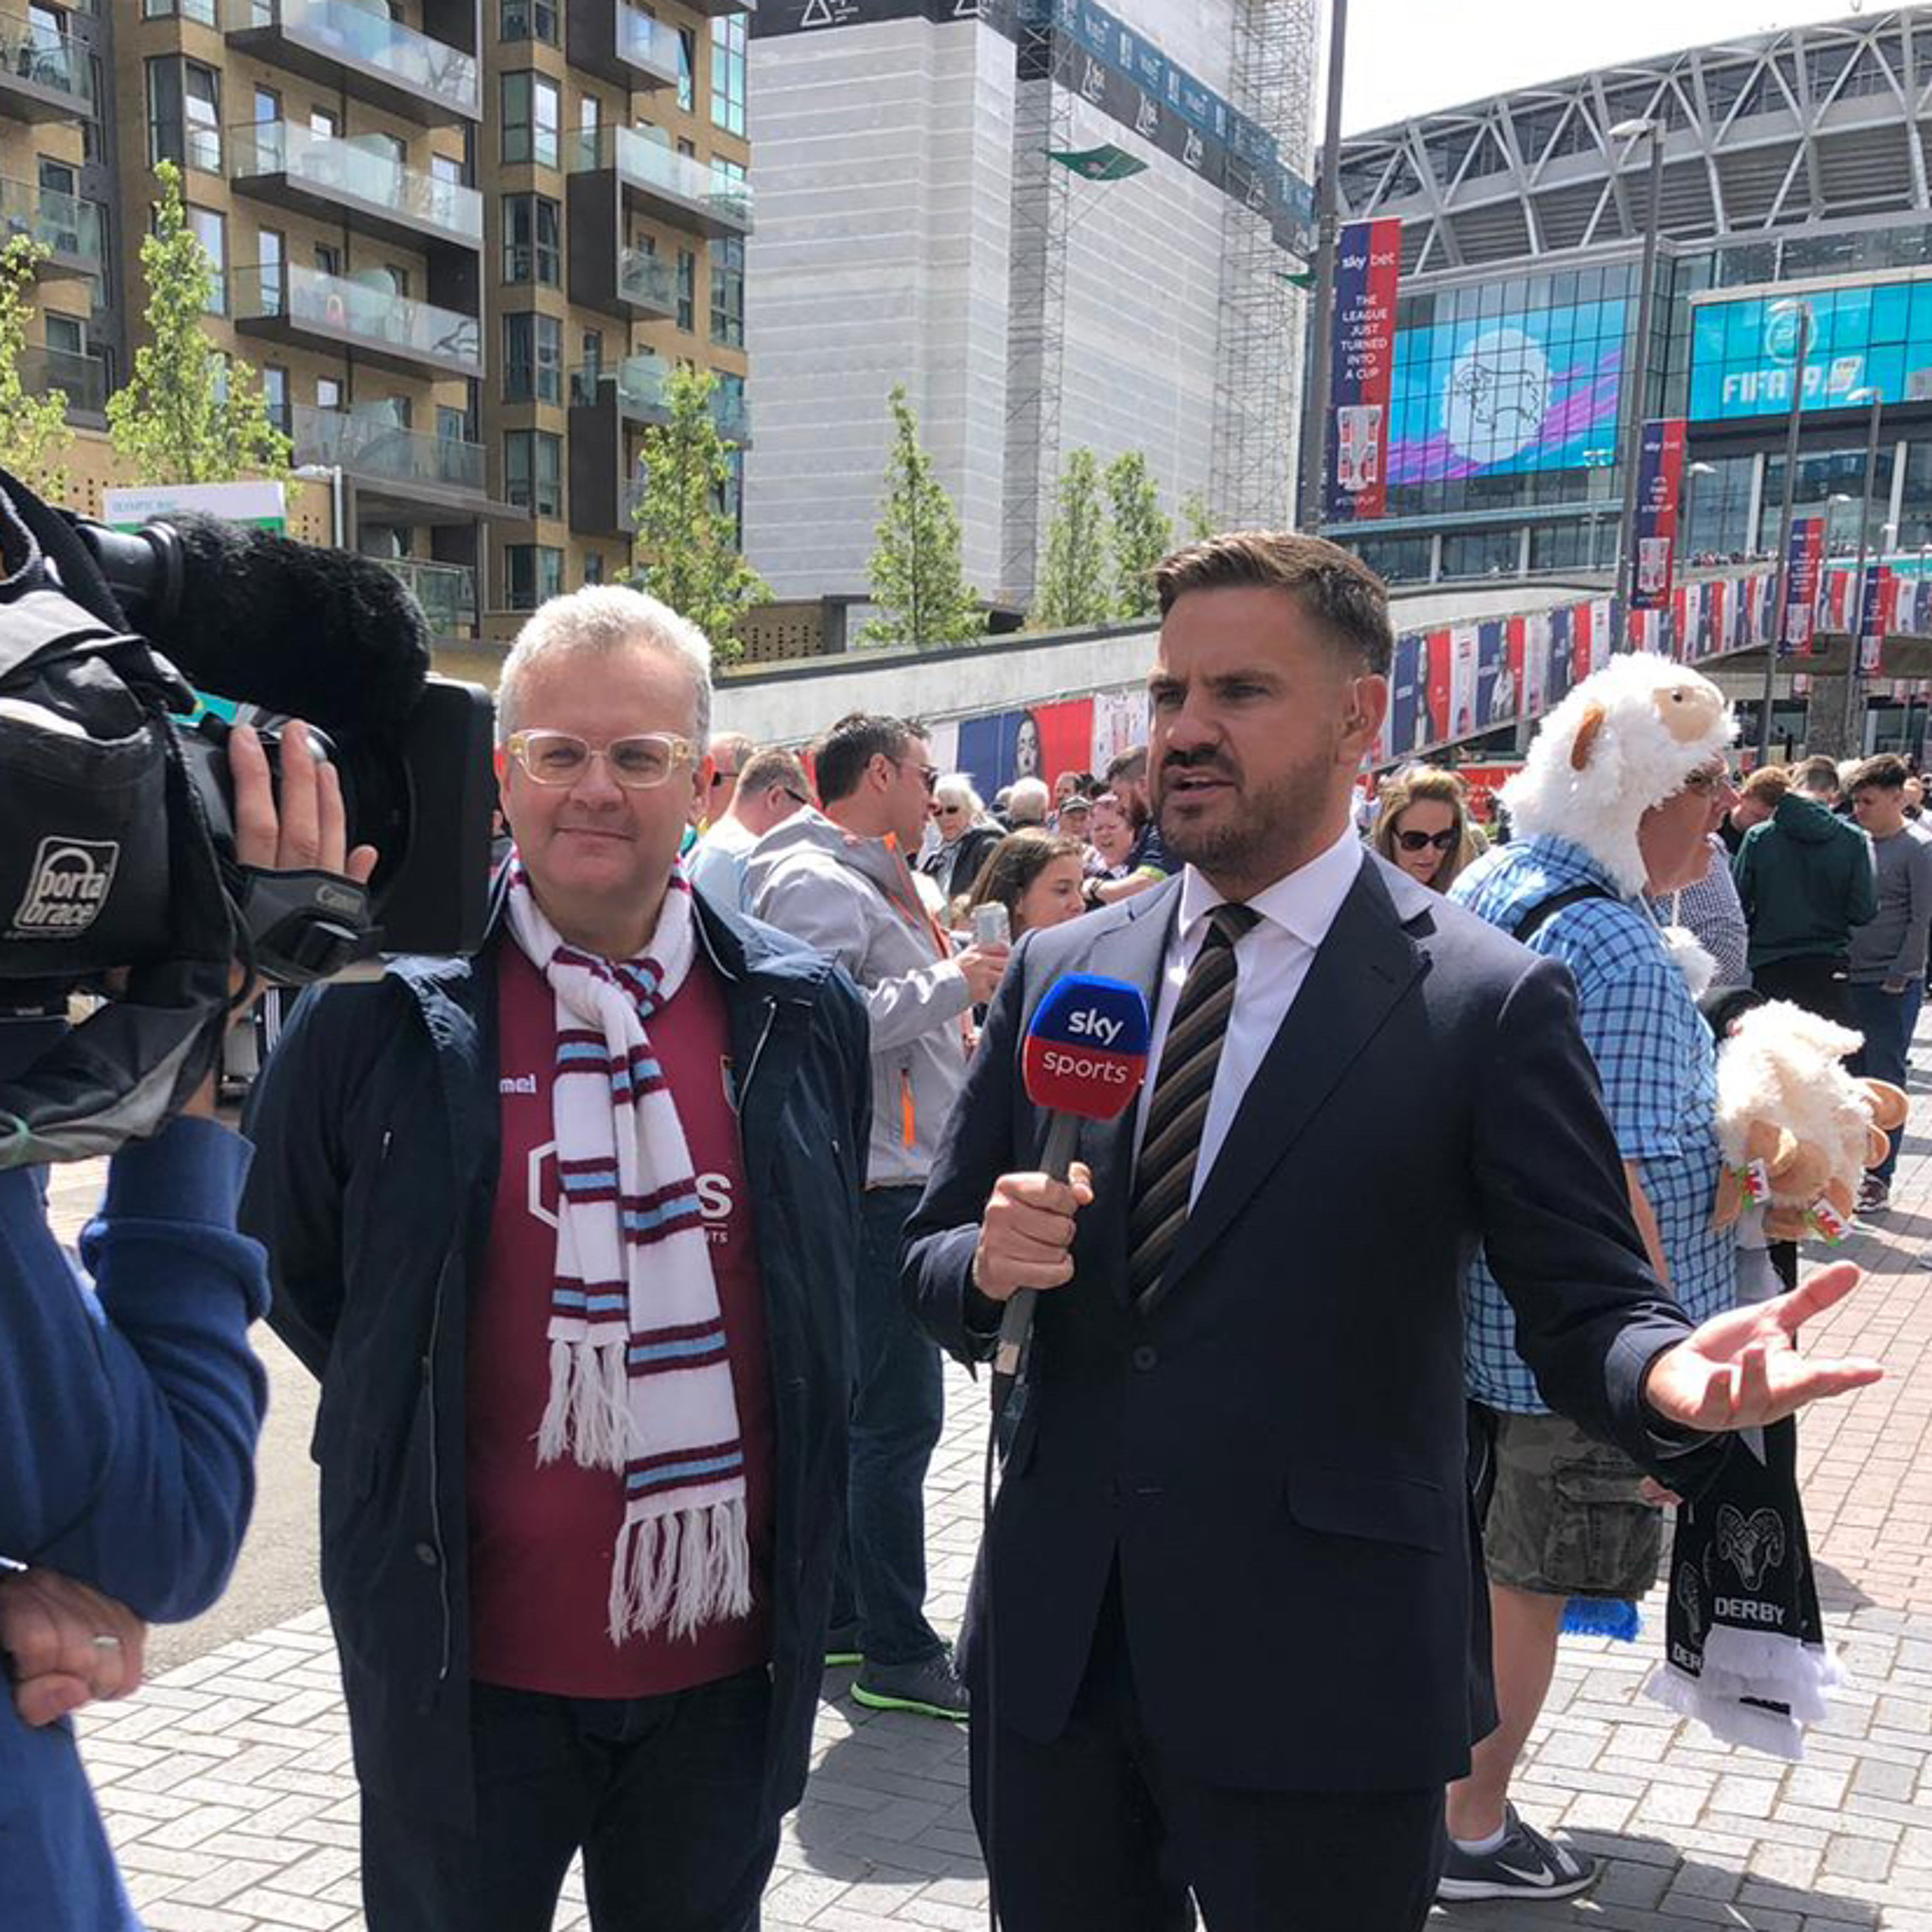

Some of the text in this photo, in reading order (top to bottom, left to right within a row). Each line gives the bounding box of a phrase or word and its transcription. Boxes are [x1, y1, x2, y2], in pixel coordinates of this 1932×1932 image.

[1342, 252, 1395, 270] sky bet
[1356, 294, 1376, 306] THE
[1342, 308, 1387, 321] LEAGUE
[1351, 323, 1379, 336] JUST
[1340, 337, 1387, 351] TURNED
[1347, 353, 1376, 365] INTO
[1723, 369, 1786, 404] FIFA
[38, 871, 106, 900] porta
[1068, 1009, 1124, 1046] sky
[1043, 1052, 1128, 1084] sports
[1714, 1597, 1785, 1625] DERBY
